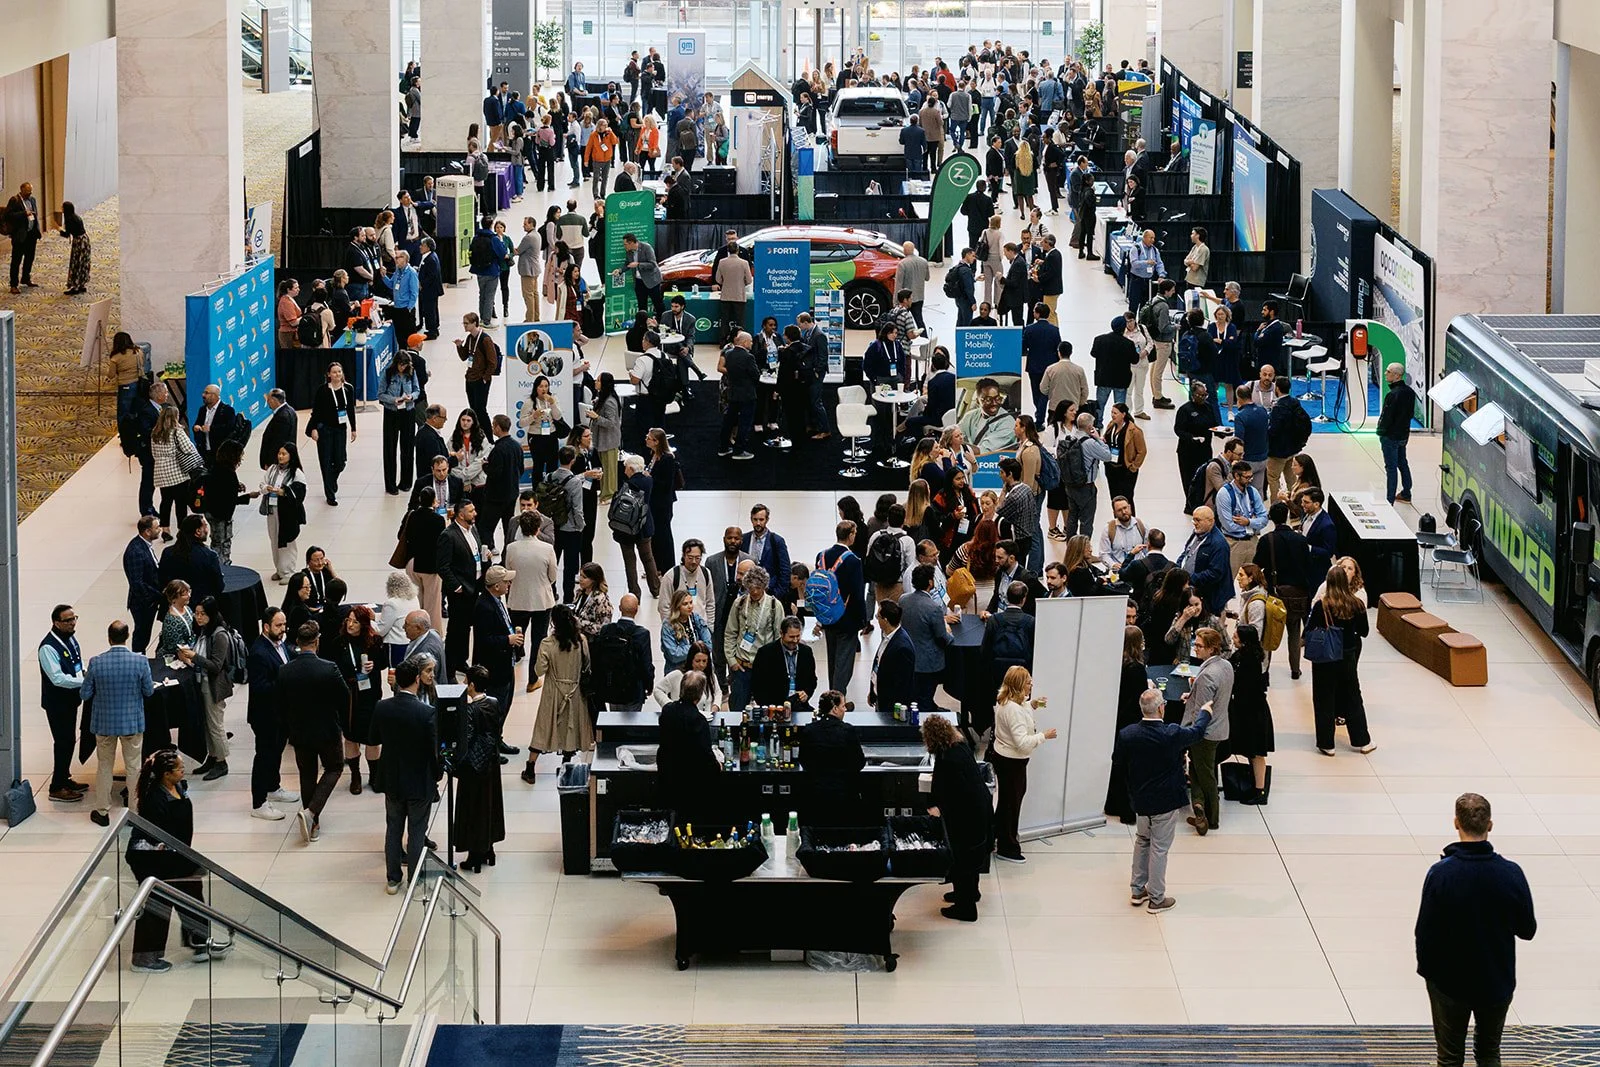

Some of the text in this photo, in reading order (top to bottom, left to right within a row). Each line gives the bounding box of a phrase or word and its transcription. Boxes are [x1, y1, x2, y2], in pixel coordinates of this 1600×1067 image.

[682, 42, 692, 51] gm
[965, 332, 992, 341] Electrify
[965, 341, 995, 350] Mobility.
[965, 352, 992, 360] Expand
